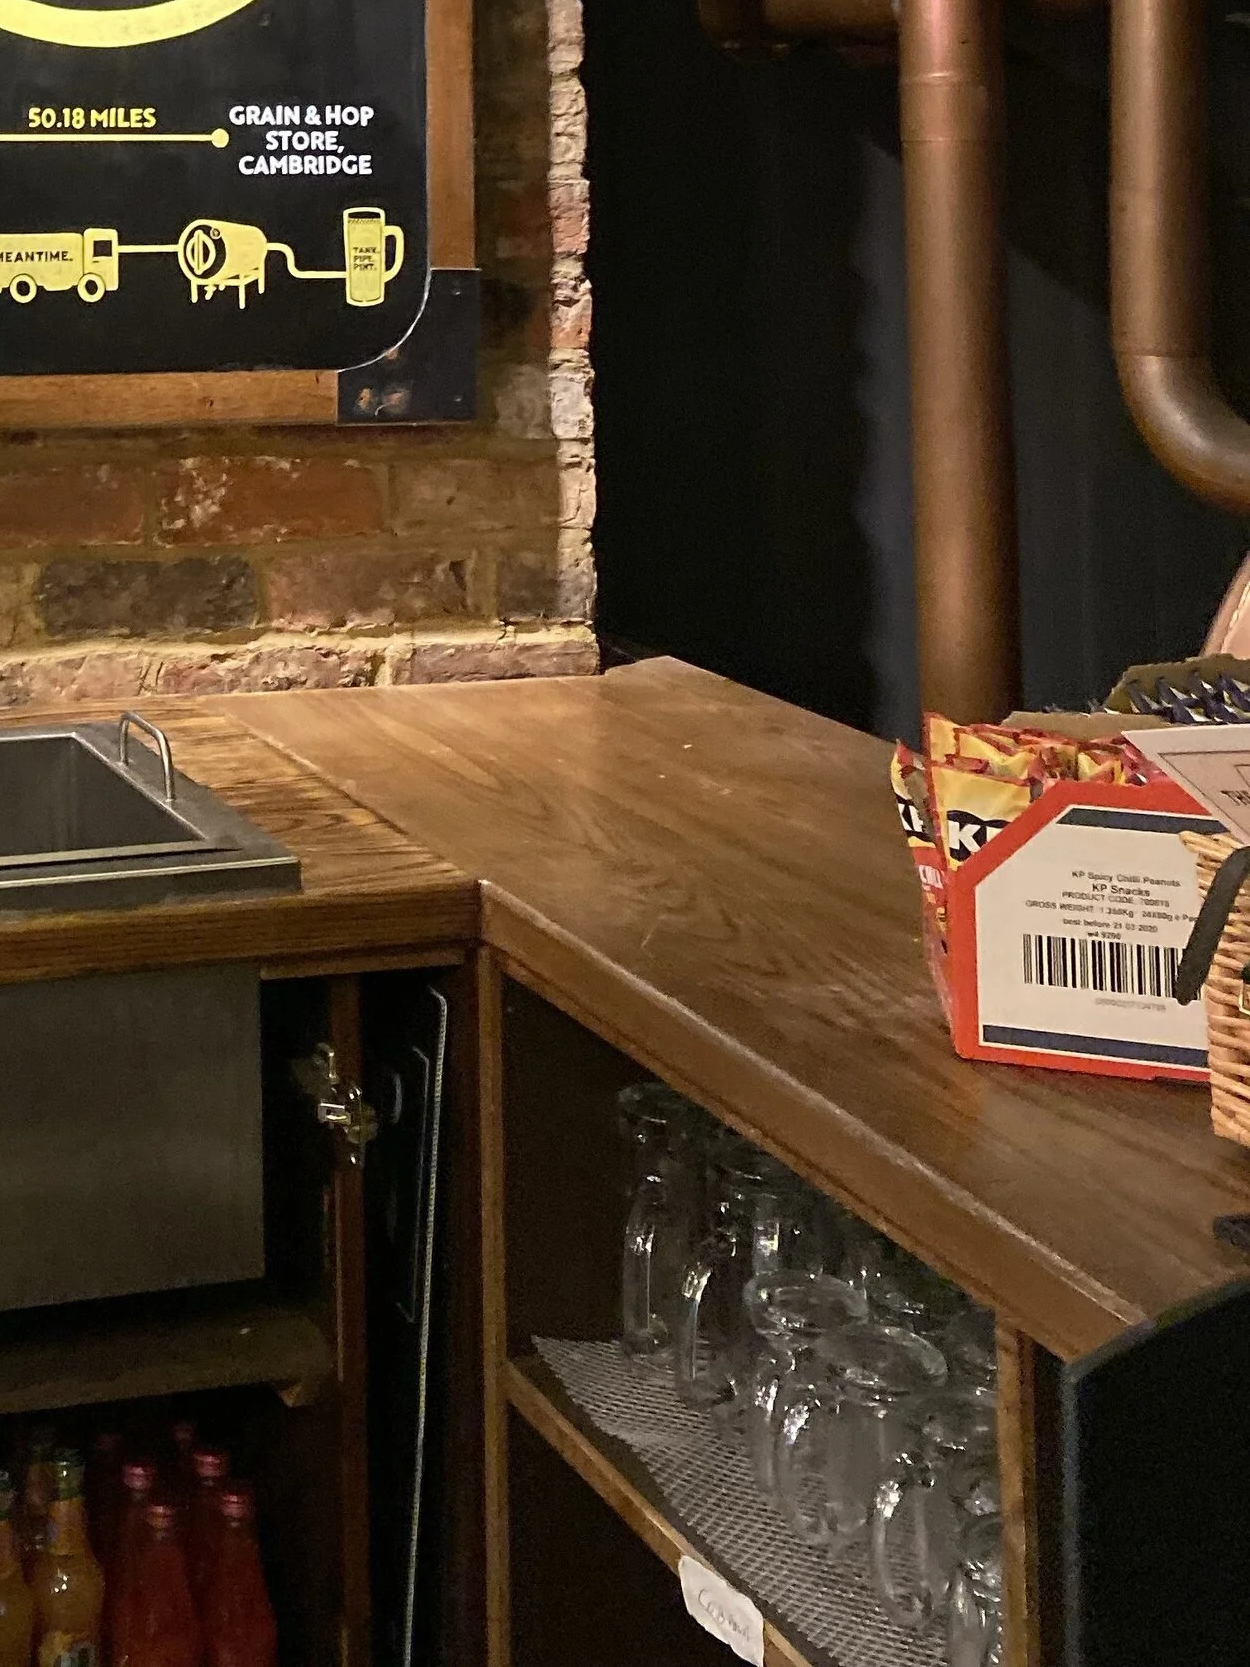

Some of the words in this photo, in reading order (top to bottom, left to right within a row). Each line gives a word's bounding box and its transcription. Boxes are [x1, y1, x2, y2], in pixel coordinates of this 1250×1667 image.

[28, 107, 86, 129] 50.18
[90, 107, 156, 129] MILES
[229, 105, 300, 126] GRAIN
[303, 105, 322, 126] &
[325, 105, 375, 126] HOP
[265, 130, 345, 153] STORE,
[238, 154, 373, 176] CAMBRIDGE
[1061, 891, 1106, 902] PRODUCT
[1092, 883, 1108, 892] KP
[1111, 885, 1150, 897] Snacks
